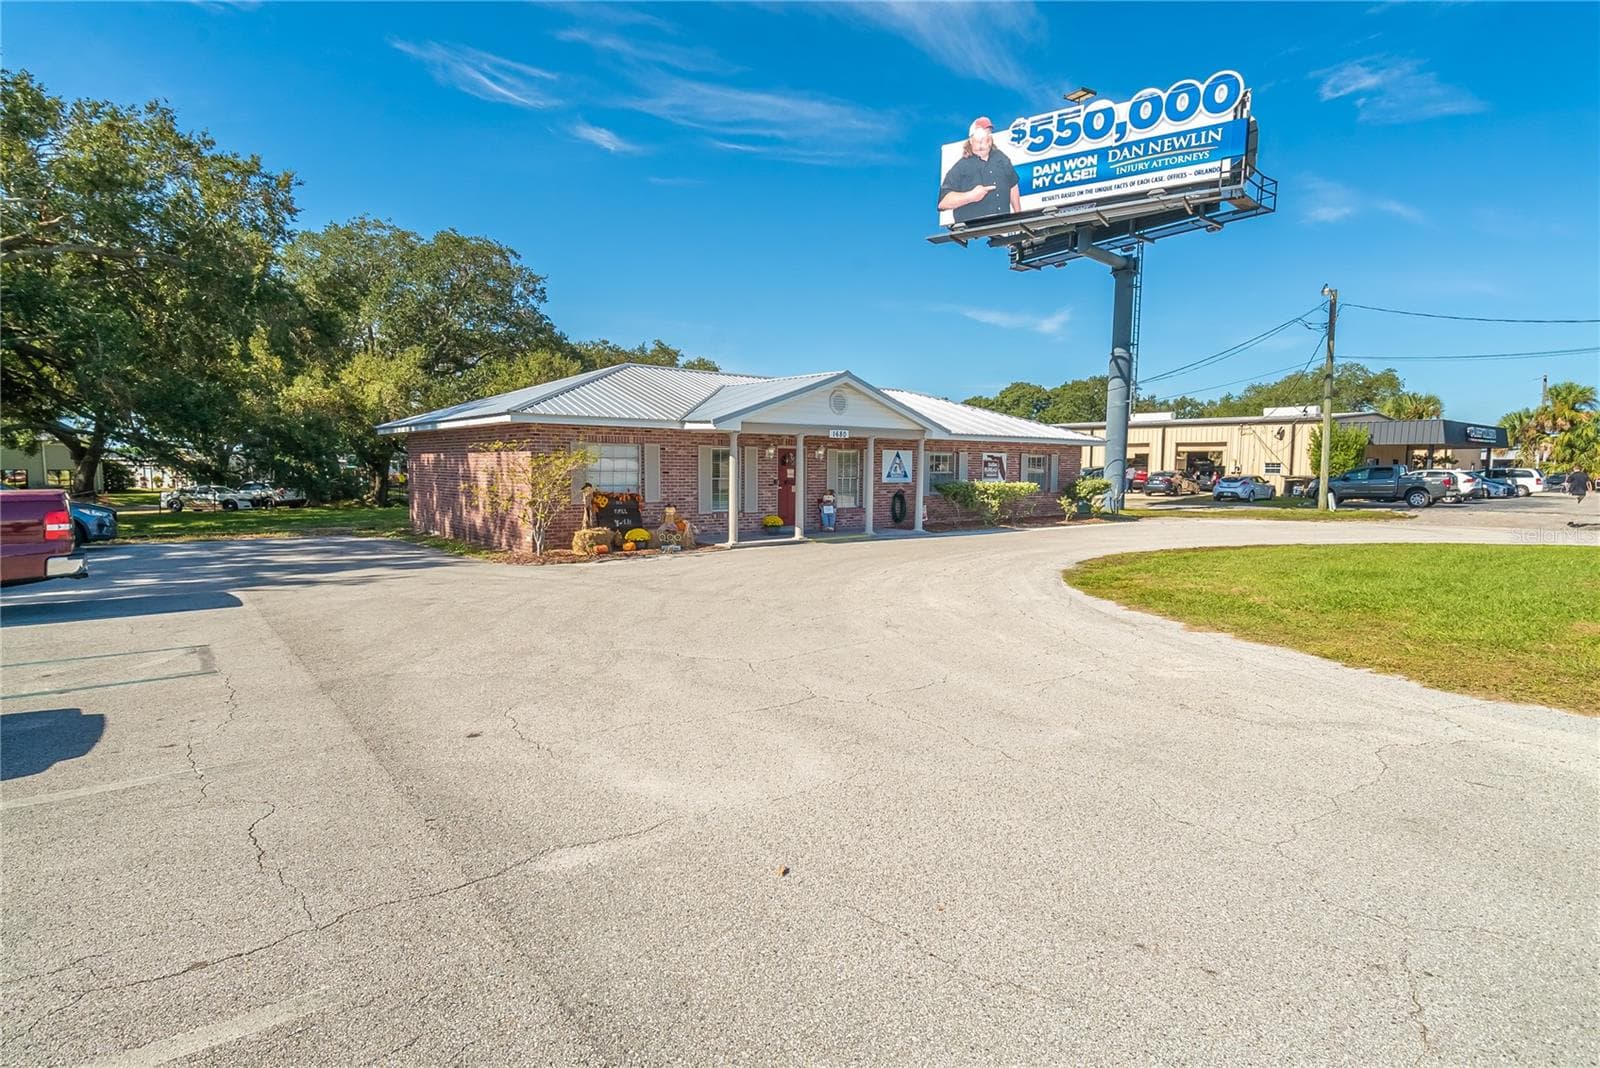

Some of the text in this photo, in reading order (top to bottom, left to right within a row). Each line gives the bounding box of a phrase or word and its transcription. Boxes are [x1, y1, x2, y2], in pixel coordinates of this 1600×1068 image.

[1011, 71, 1242, 150] $550,000
[1107, 127, 1223, 163] DAN NEWLIN
[1033, 154, 1098, 177] DAN WON
[1116, 150, 1210, 175] INJURY ATTORNEYS
[1032, 167, 1098, 189] MY CASE!!
[1041, 194, 1060, 202] RESULTS
[1060, 191, 1076, 199] BASED
[1094, 185, 1113, 194] UNIQUE
[1114, 182, 1128, 190] FACTS
[1137, 177, 1150, 185] EACH
[1166, 172, 1187, 181] OFFICES
